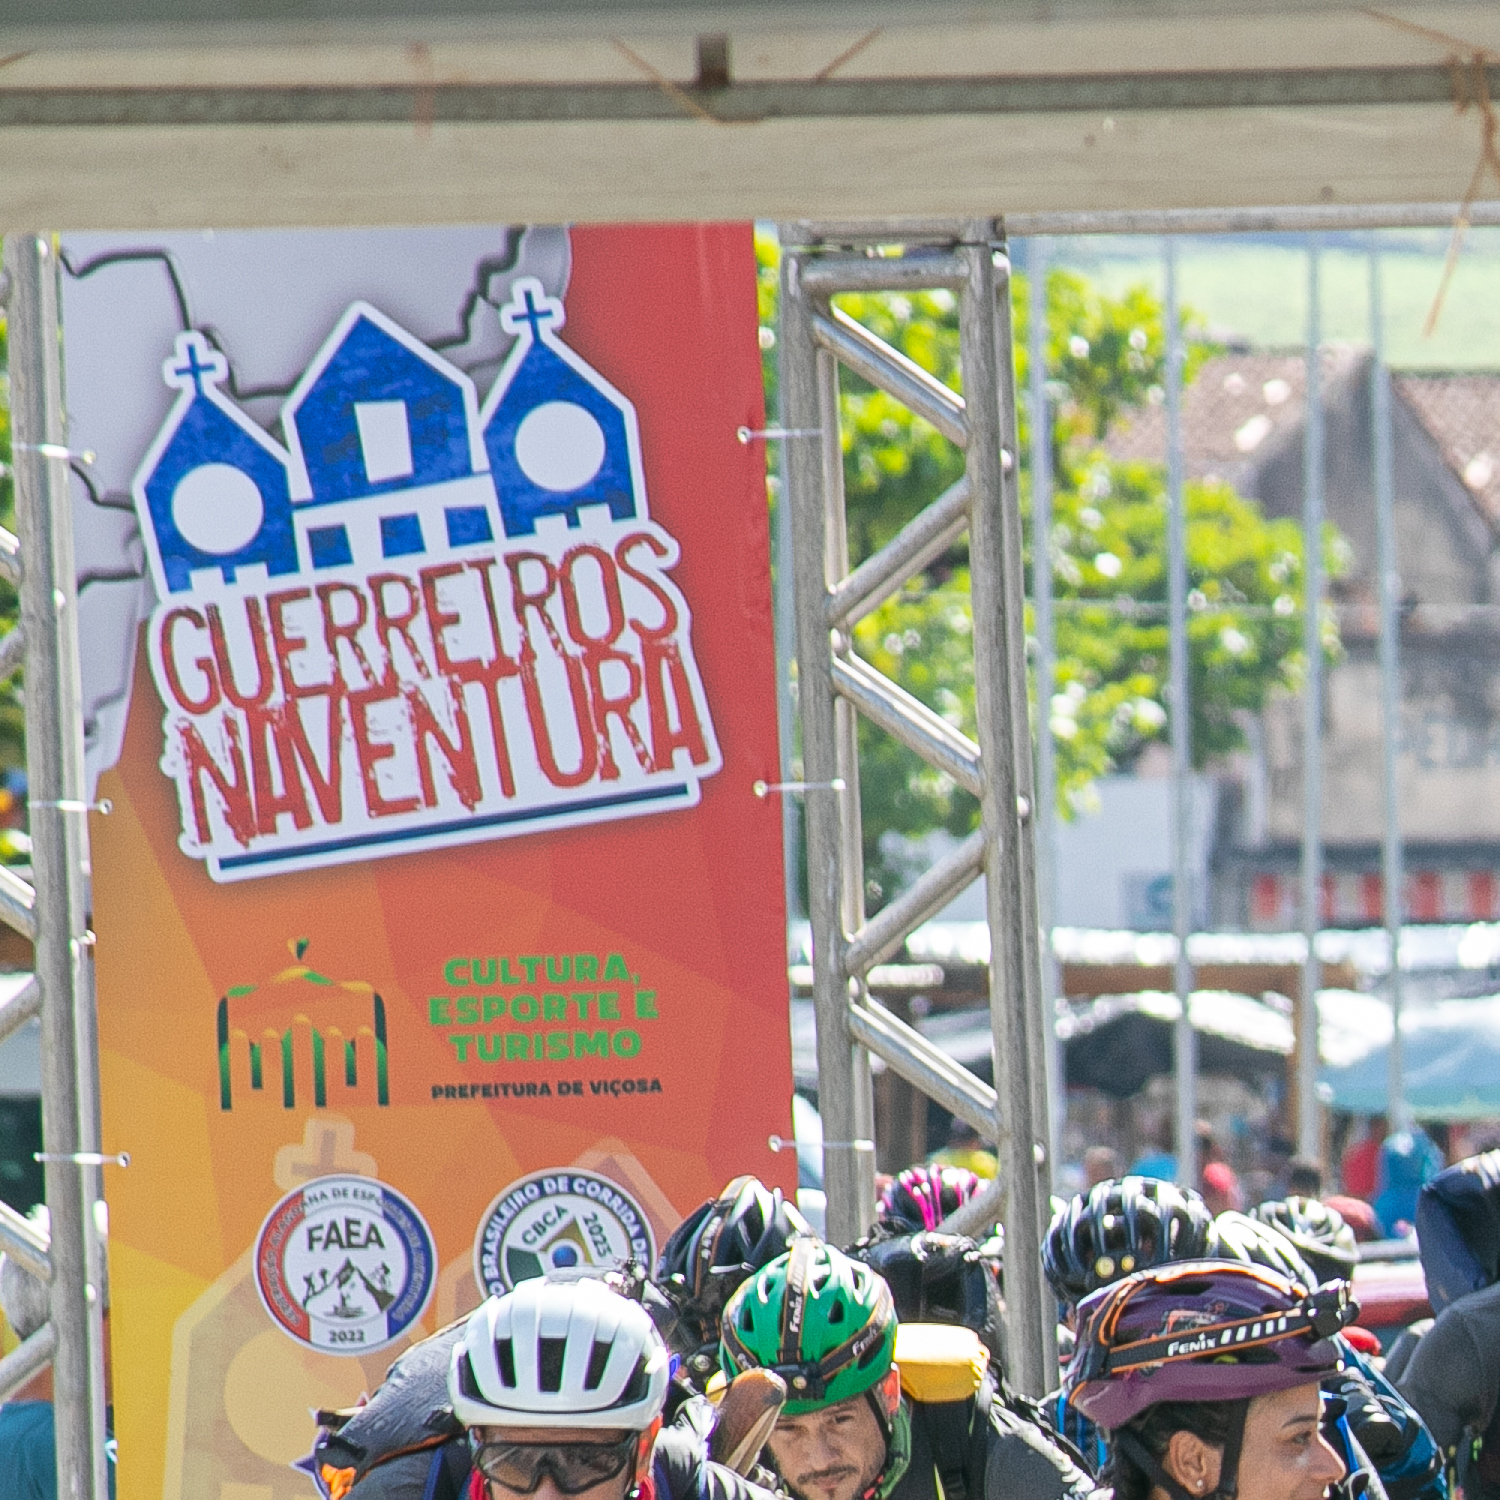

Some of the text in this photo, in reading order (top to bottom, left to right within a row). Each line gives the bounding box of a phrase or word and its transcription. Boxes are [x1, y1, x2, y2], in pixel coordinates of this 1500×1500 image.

[159, 533, 673, 716] GUERREIROS
[443, 953, 642, 988] CULTURA,
[430, 989, 659, 1026] ESPORTE E
[449, 1029, 643, 1063] TURISMO
[431, 1077, 663, 1100] PREFEITURA DE VIÇOSA
[306, 1216, 386, 1252] FAEA
[482, 1182, 542, 1278] BRASILEIRO
[543, 1176, 569, 1195] DE
[572, 1177, 642, 1238] CORRIDA
[521, 1203, 569, 1246] CBCA
